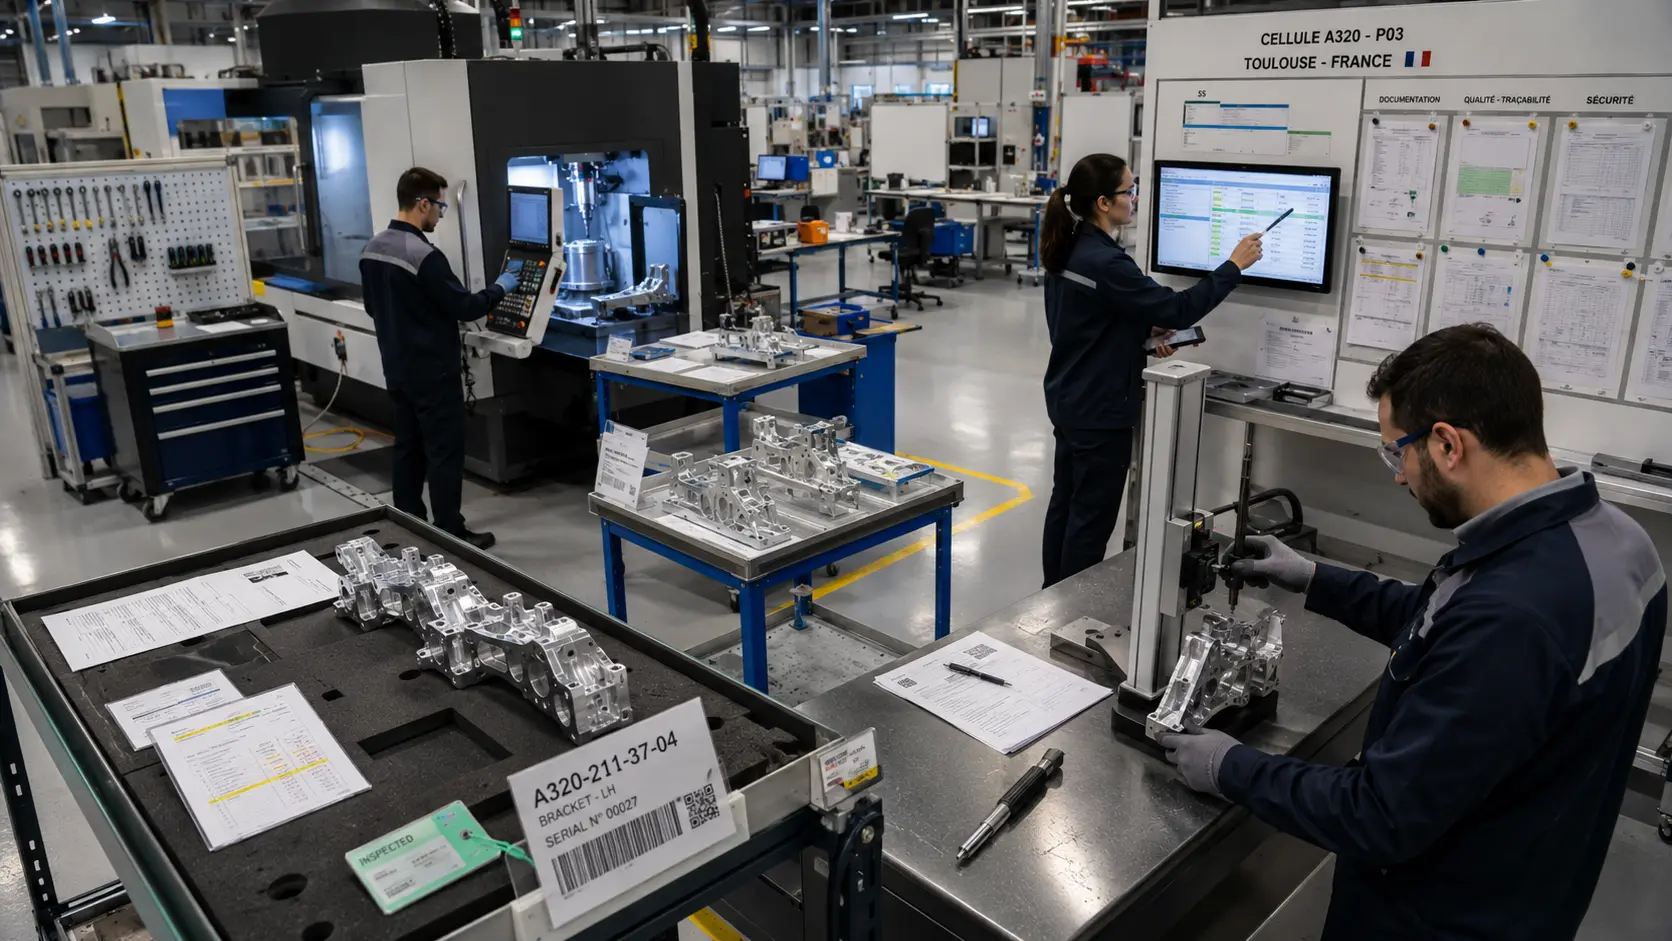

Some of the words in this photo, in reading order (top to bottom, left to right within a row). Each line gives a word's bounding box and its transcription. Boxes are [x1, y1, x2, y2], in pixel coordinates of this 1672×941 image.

[1260, 31, 1320, 46] CELLULE
[1324, 29, 1361, 44] A320
[1375, 27, 1404, 42] P03
[1244, 56, 1317, 70] TOULOUSE
[1331, 54, 1392, 69] FRANCE
[1379, 95, 1440, 104] DOCUMENTATION
[1464, 95, 1496, 105] QUALITÉ
[1501, 95, 1551, 106] TRAÇABILITÉ
[1586, 94, 1635, 105] SÉCURITÉ
[535, 731, 678, 808] A320-211-37-04
[538, 795, 592, 827] BRACKET
[600, 784, 617, 801] LH
[545, 821, 588, 848] SERIAL
[606, 796, 638, 819] 00027
[359, 834, 414, 867] INSPECTED
